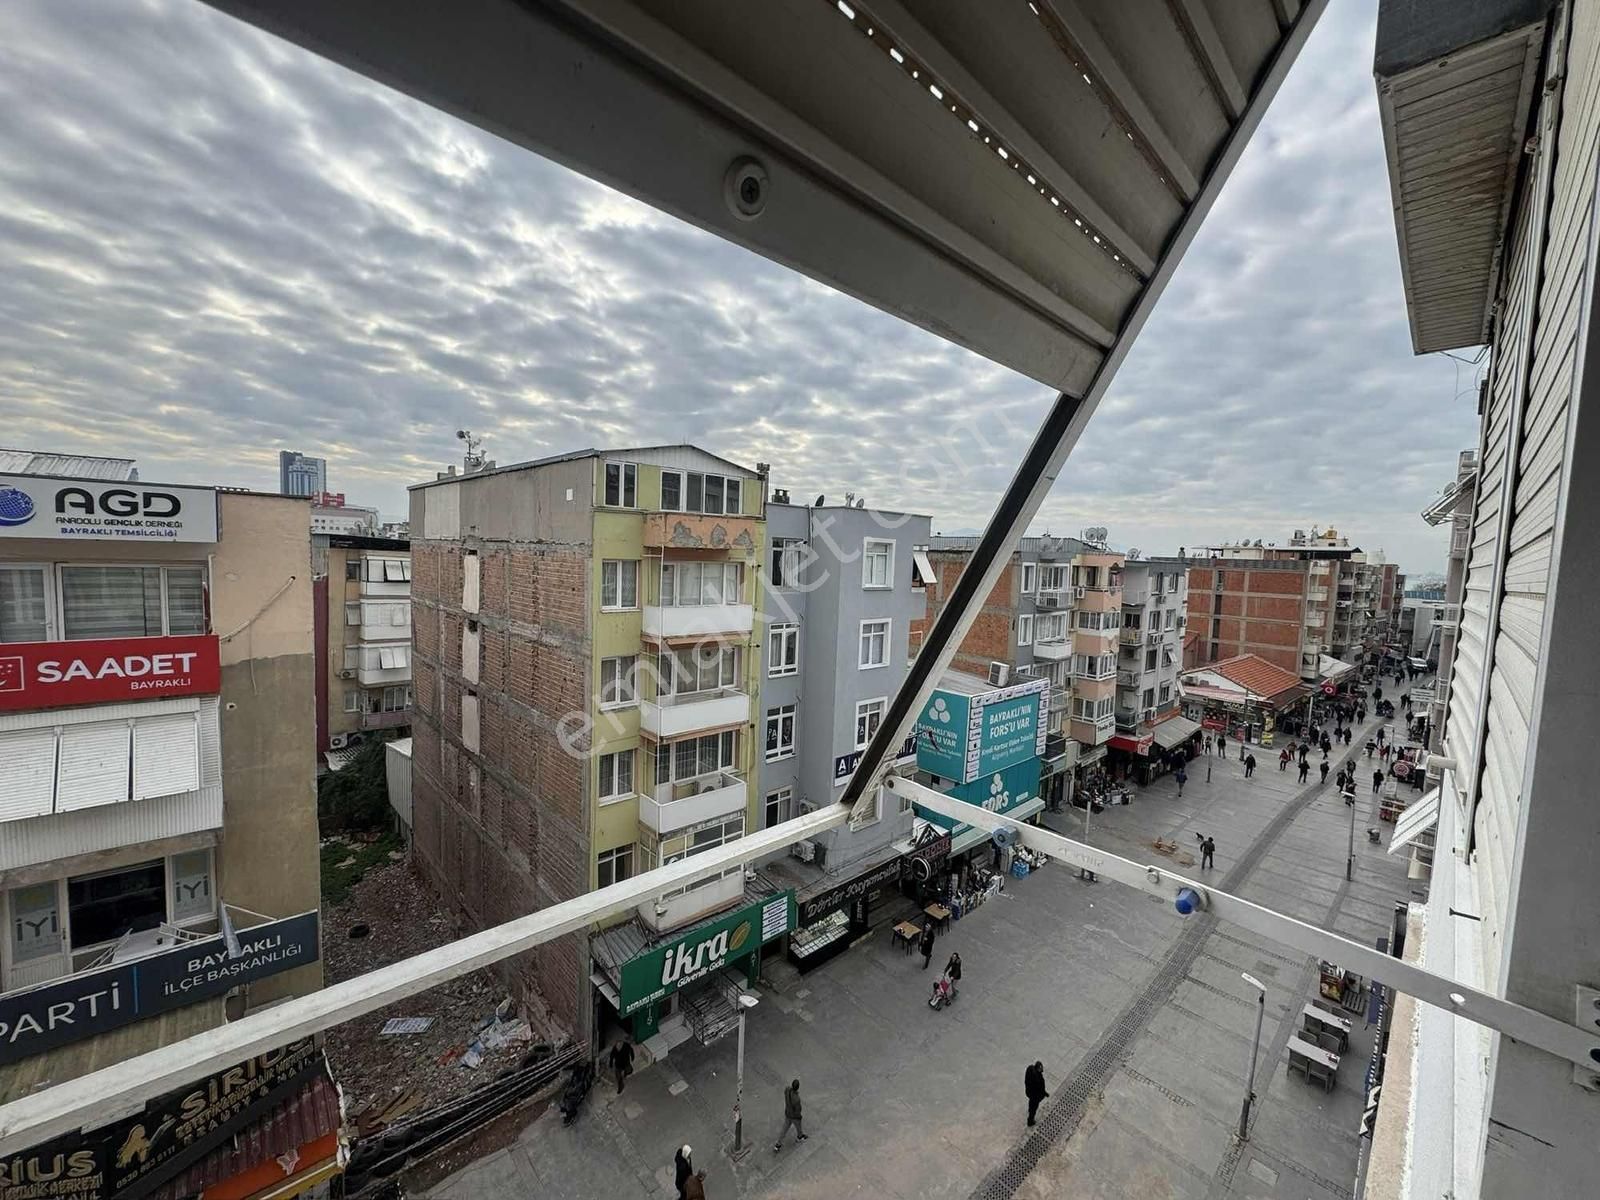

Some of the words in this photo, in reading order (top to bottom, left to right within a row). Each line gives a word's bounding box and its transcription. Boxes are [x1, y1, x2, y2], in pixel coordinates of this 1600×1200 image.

[55, 487, 181, 518] AGD
[56, 516, 102, 526] ANADOLU
[61, 527, 113, 535] BAYRAKLI
[37, 652, 197, 683] SAADET
[130, 677, 192, 690] BAYRAKLI
[989, 704, 1032, 724] BAYRAKLI'NIN
[989, 721, 1015, 739] FORS'U
[1016, 717, 1030, 730] VAR
[188, 934, 281, 973] BAYAKLI
[661, 930, 728, 986] ikra
[164, 974, 204, 996] İLÇE
[207, 943, 302, 982] BAŞKANLIĞI
